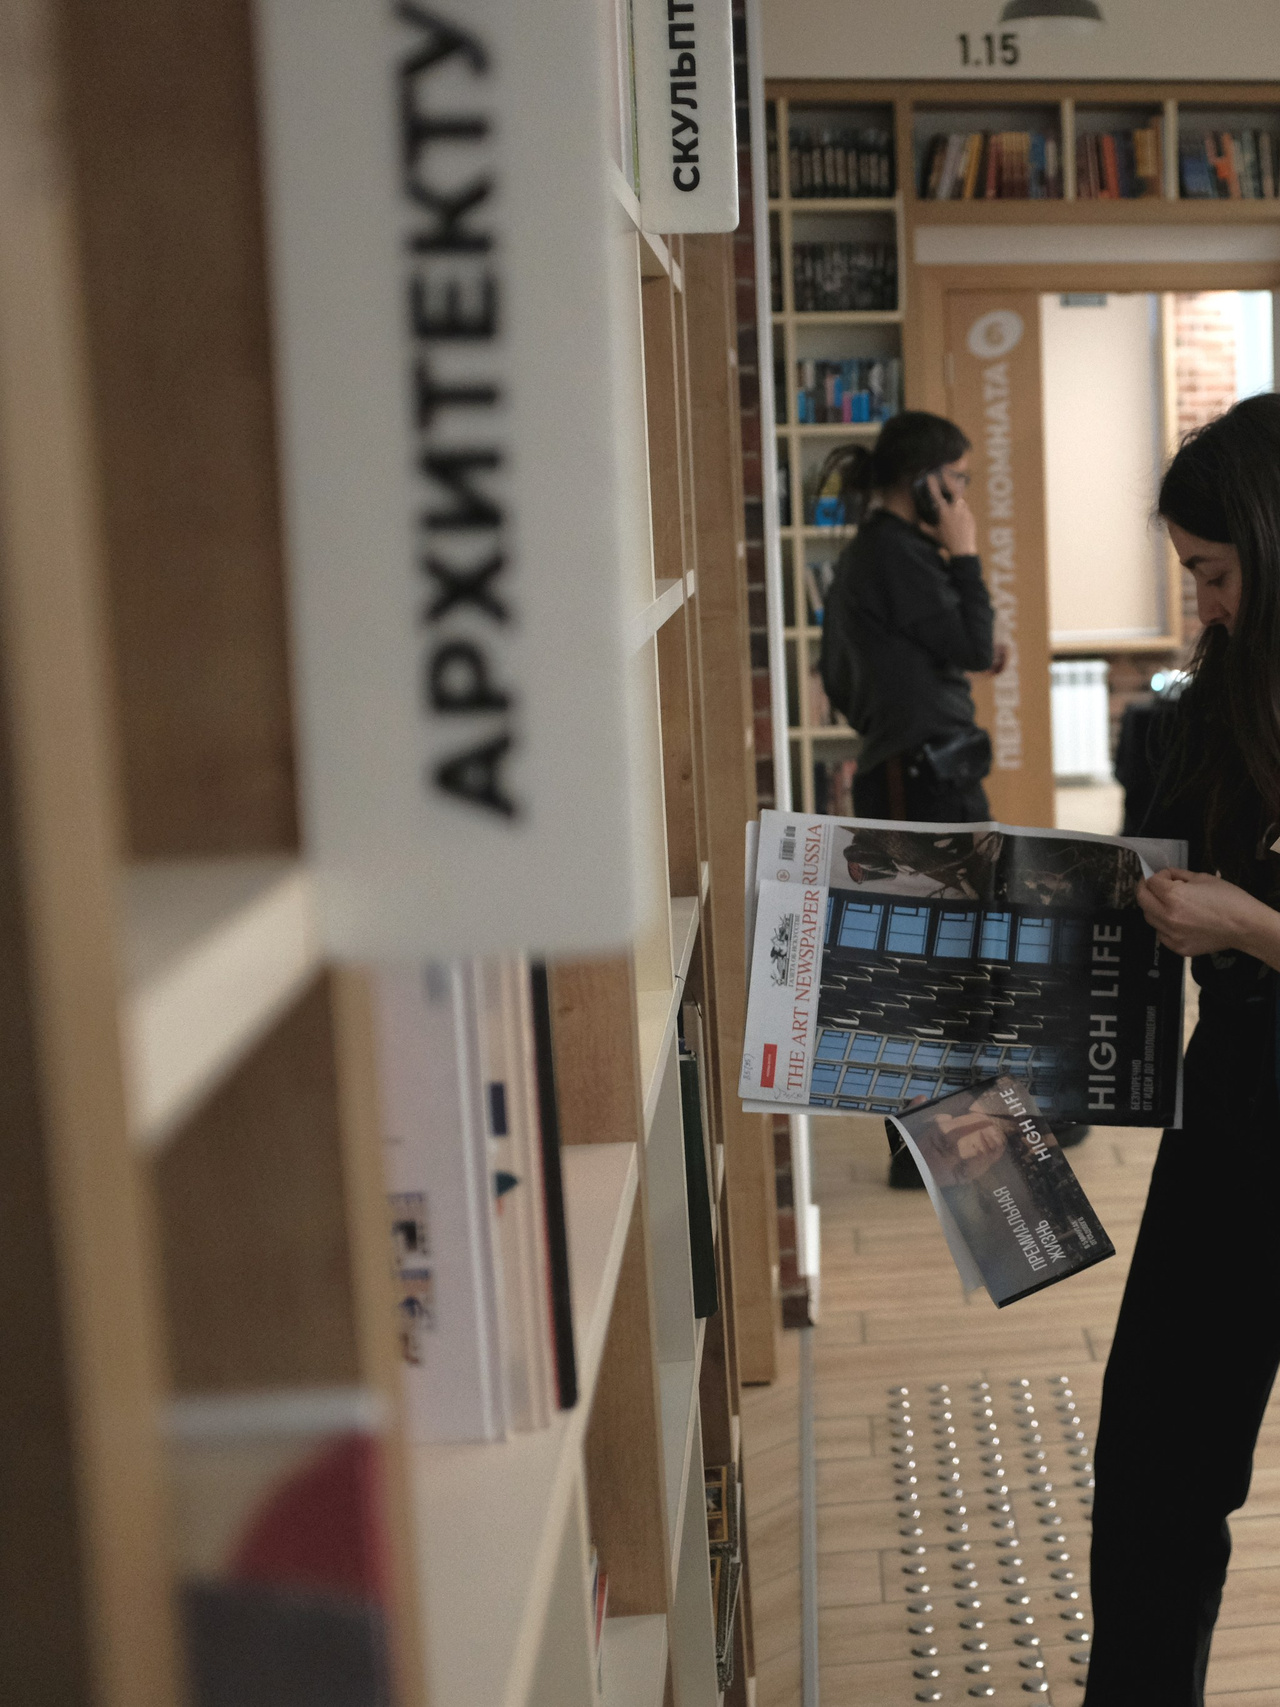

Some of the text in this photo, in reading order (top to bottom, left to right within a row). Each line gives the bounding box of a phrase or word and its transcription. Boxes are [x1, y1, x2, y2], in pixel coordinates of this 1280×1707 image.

[958, 33, 1019, 66] 1.15
[982, 361, 1013, 518] КОМНАТА
[802, 824, 822, 886] RUSSIA
[794, 890, 820, 1002] NEWSPAPER
[792, 1007, 809, 1047] ART
[1088, 924, 1122, 1110] HIGH LIFE
[787, 1051, 805, 1091] THE
[1130, 1059, 1142, 1111] БЕЗУПРЕЧНО
[1143, 1005, 1157, 1111] ОТ ИДЕИ ДО ВОПЛОЩЕНИЯ
[999, 1088, 1051, 1162] HIGH LIFE
[993, 1186, 1048, 1272] ПРЕМИАЛЬНАЯ
[1038, 1219, 1066, 1263] ЖИЗНЬ
